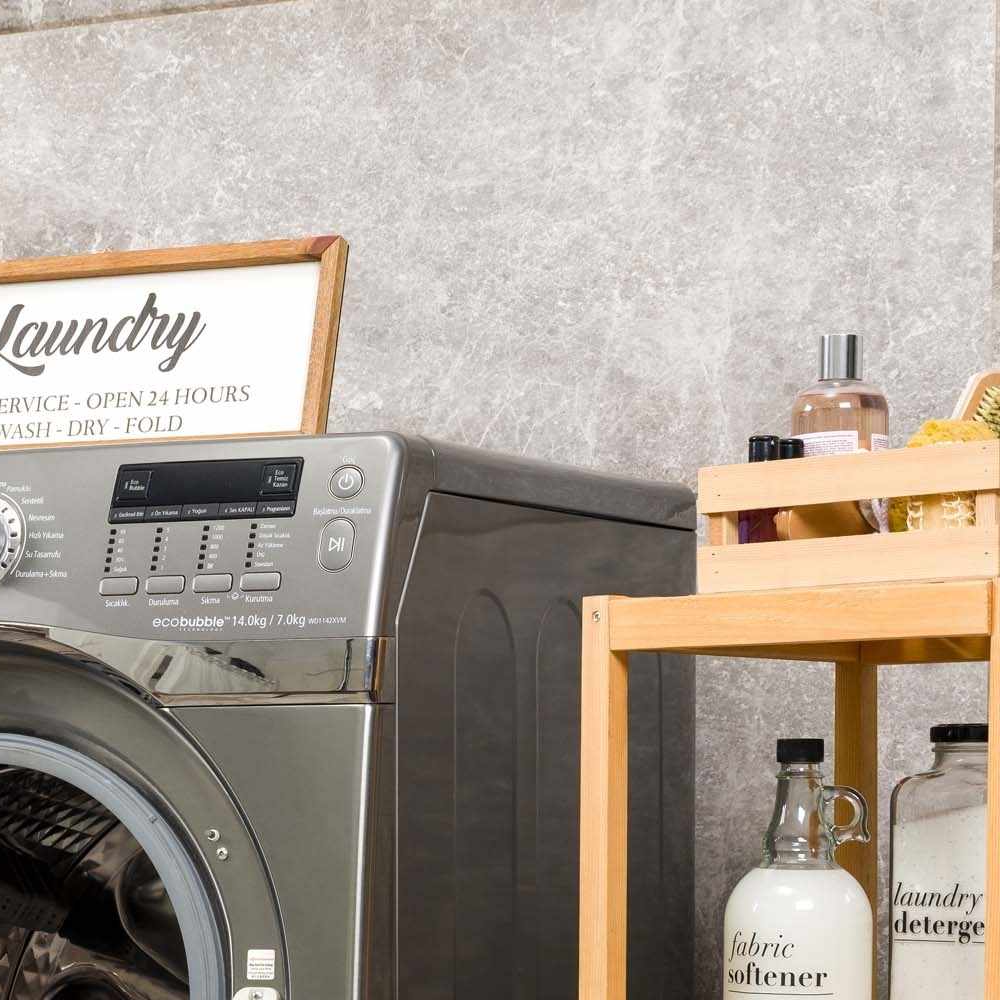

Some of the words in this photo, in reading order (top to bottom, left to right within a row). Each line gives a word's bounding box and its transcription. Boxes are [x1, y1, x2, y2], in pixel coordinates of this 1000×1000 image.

[86, 391, 144, 410] OPEN
[148, 390, 169, 407] 24
[174, 384, 251, 405] HOURS
[67, 417, 110, 437] DRY
[124, 414, 183, 434] FOLD
[232, 614, 267, 629] 14.0kg
[277, 613, 306, 630] 7.0kg
[893, 881, 984, 915] laundry
[728, 928, 795, 962] fabric
[728, 962, 828, 988] softener
